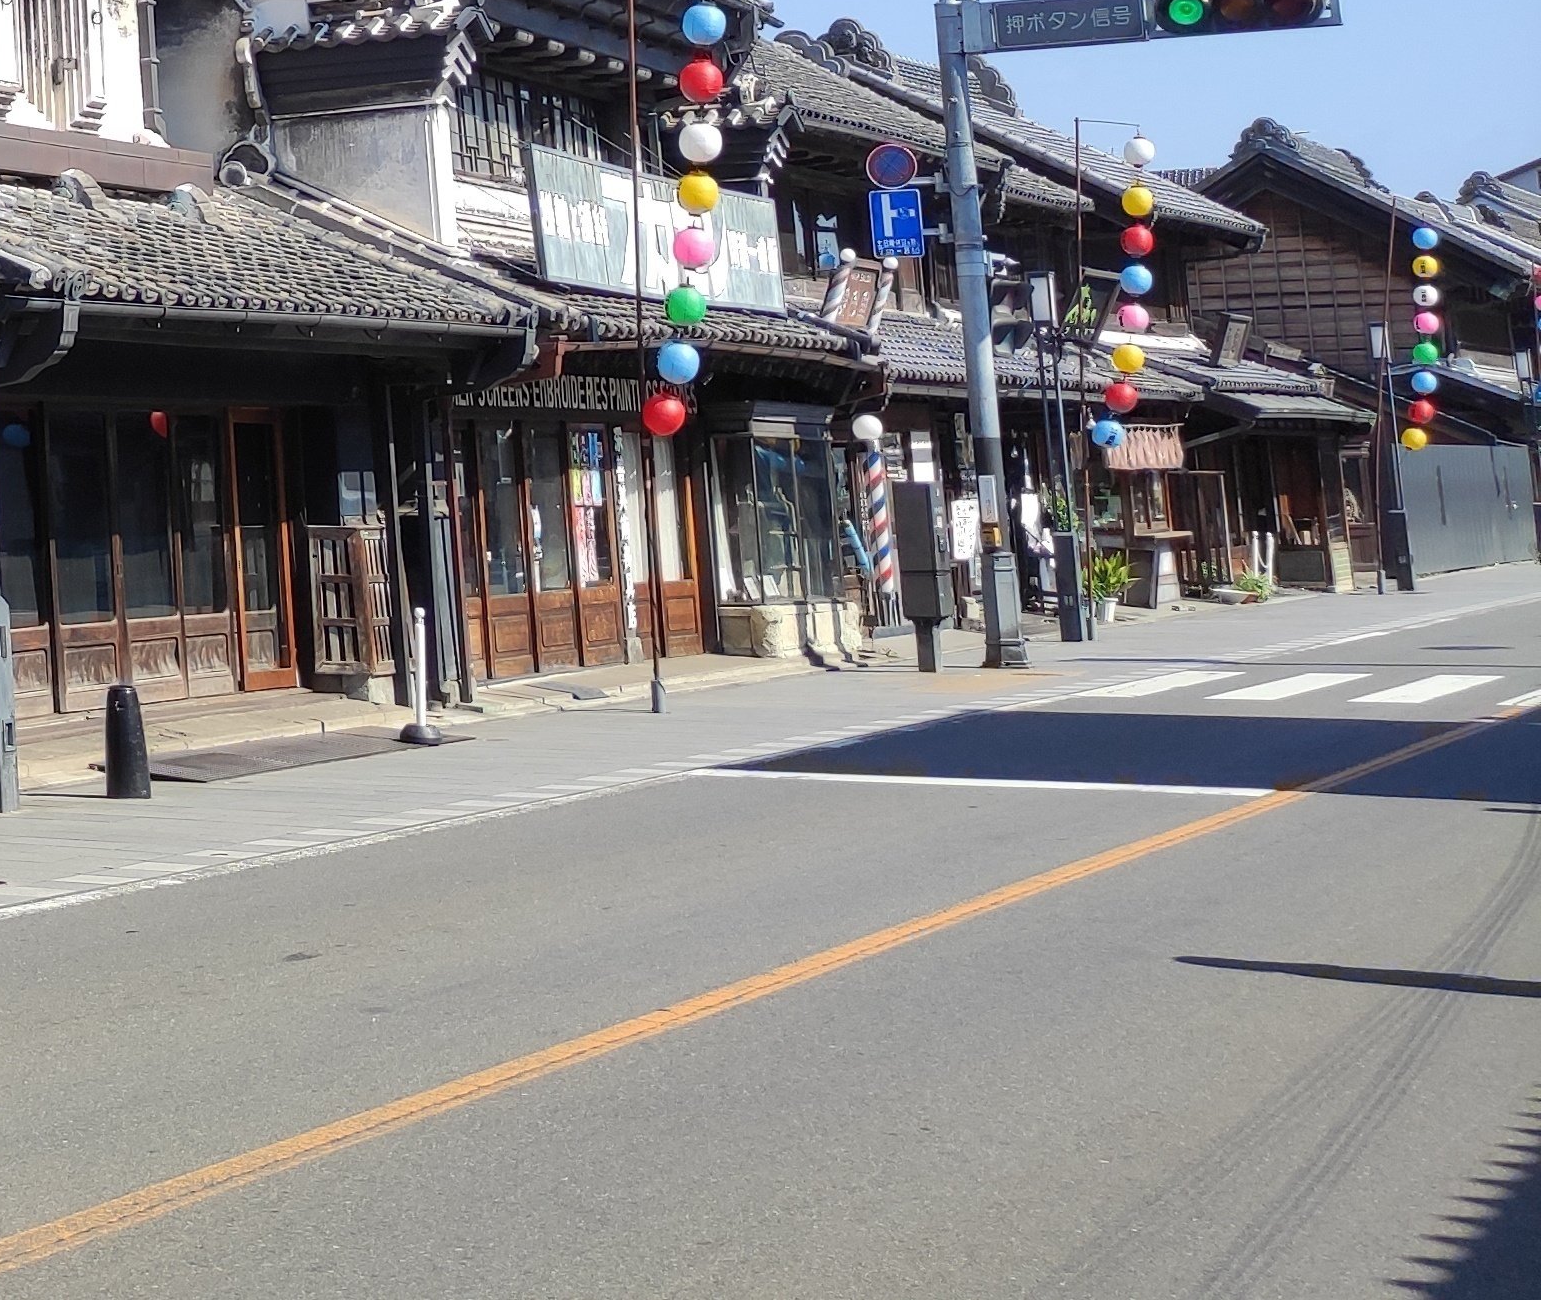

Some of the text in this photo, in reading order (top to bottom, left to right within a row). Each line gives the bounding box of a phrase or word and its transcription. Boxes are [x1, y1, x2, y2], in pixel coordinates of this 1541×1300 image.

[1006, 5, 1132, 35] 押ボタン信号
